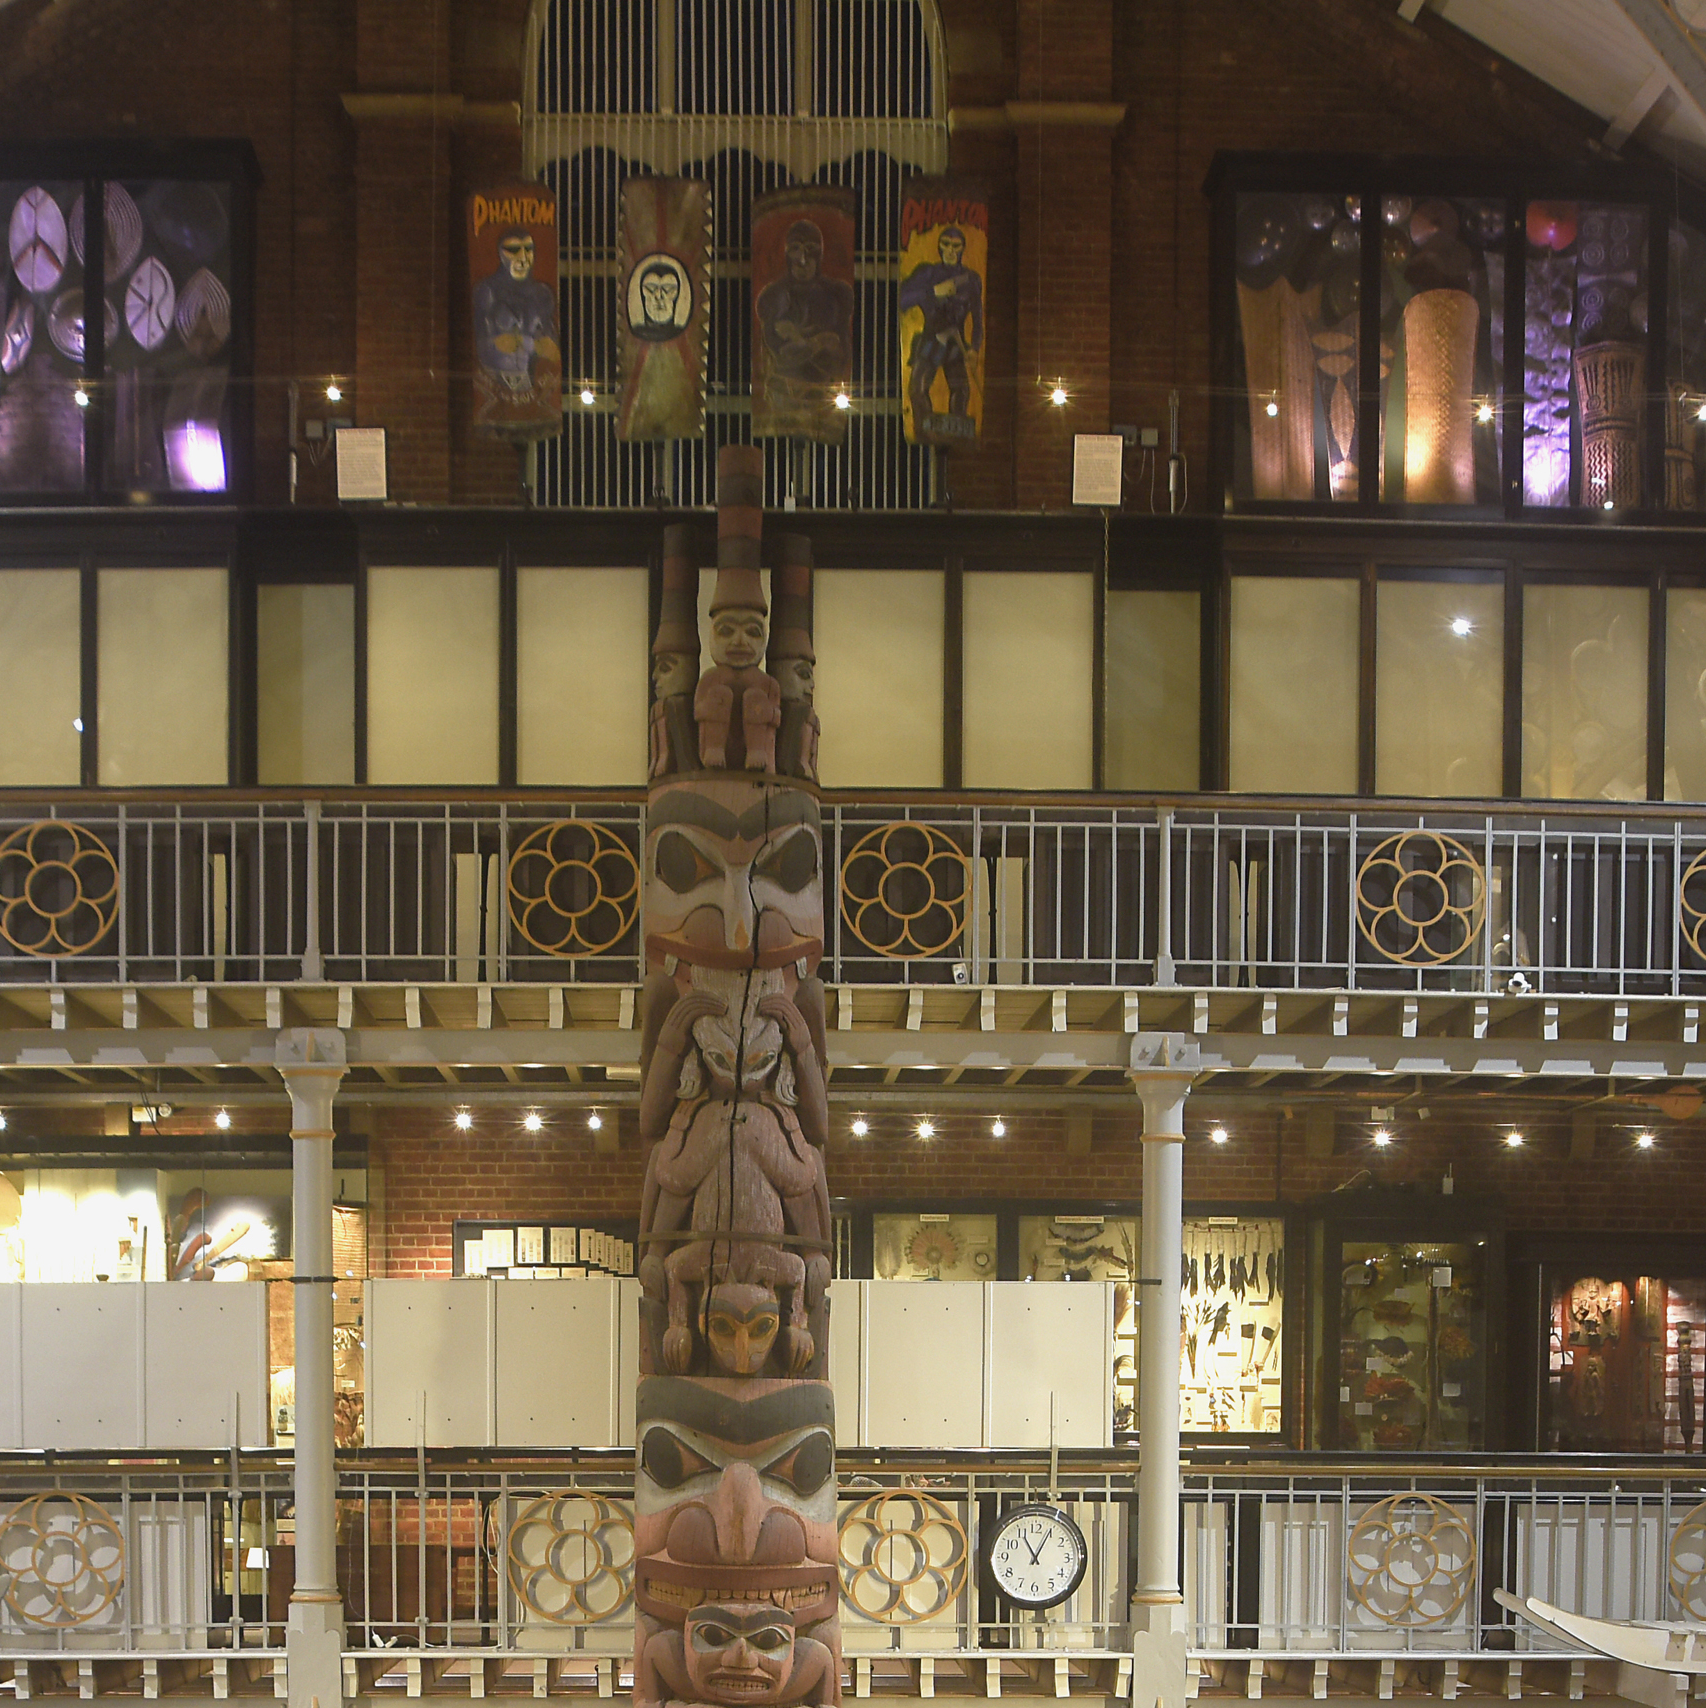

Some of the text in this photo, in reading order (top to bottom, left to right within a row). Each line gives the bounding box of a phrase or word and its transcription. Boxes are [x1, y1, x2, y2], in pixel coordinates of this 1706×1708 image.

[473, 193, 555, 238] PHANTOM
[1030, 1523, 1042, 1534] 12
[1006, 1539, 1019, 1550] 10
[1057, 1537, 1064, 1547] 2
[1001, 1552, 1009, 1562] 9
[1064, 1553, 1070, 1563] 3
[1005, 1567, 1013, 1577] 8
[1057, 1567, 1064, 1577] 4
[1018, 1578, 1024, 1588] 7
[1031, 1582, 1039, 1592] 6
[1047, 1578, 1055, 1591] 5
